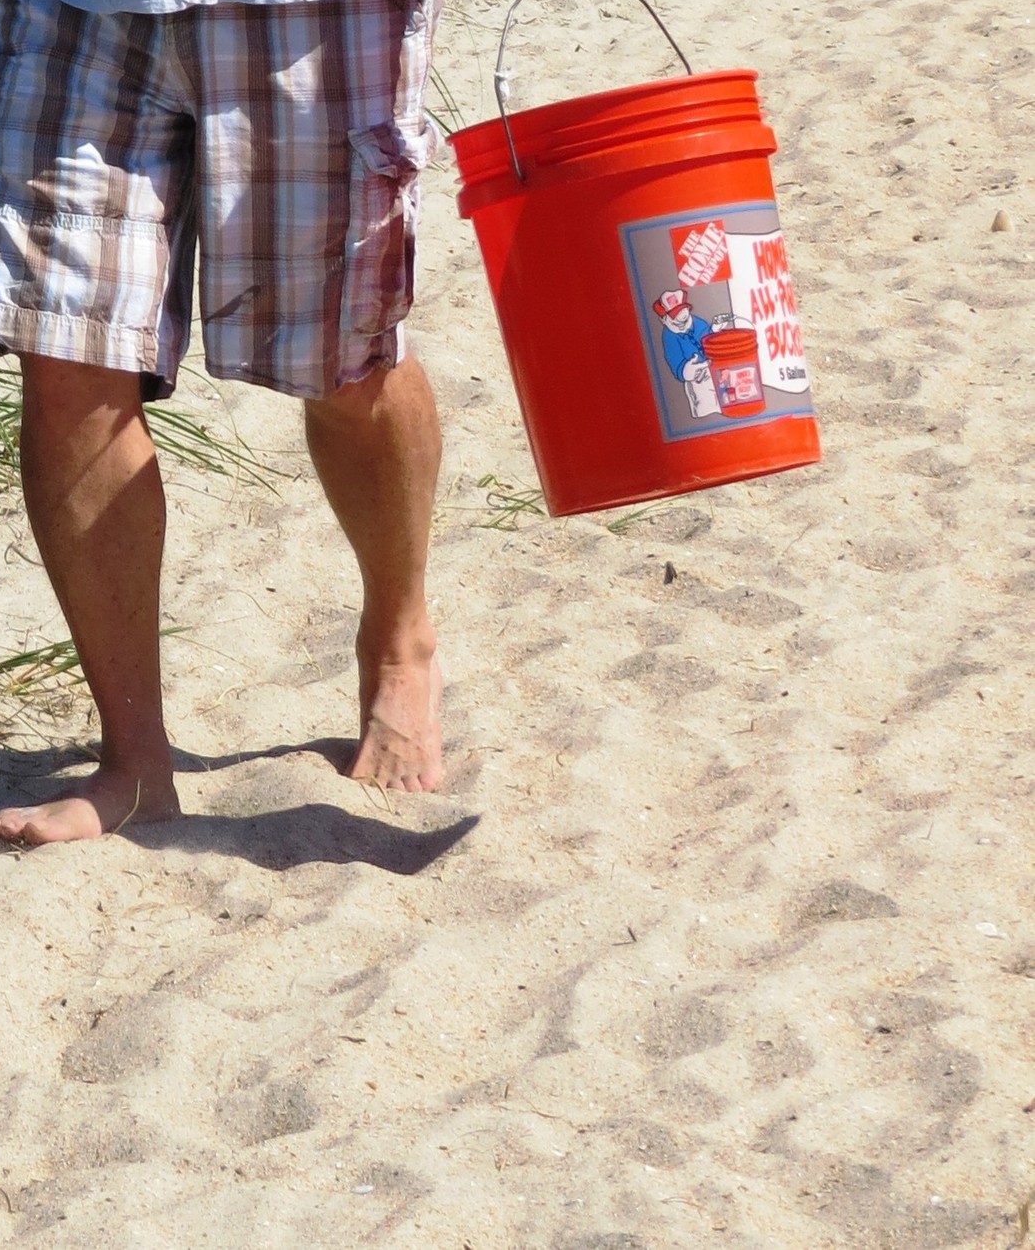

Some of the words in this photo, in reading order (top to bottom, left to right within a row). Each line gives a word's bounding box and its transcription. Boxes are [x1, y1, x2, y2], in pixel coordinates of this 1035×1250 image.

[678, 230, 701, 257] THE
[678, 222, 726, 287] HOME
[699, 240, 729, 285] DEPOT
[779, 368, 786, 381] 5
